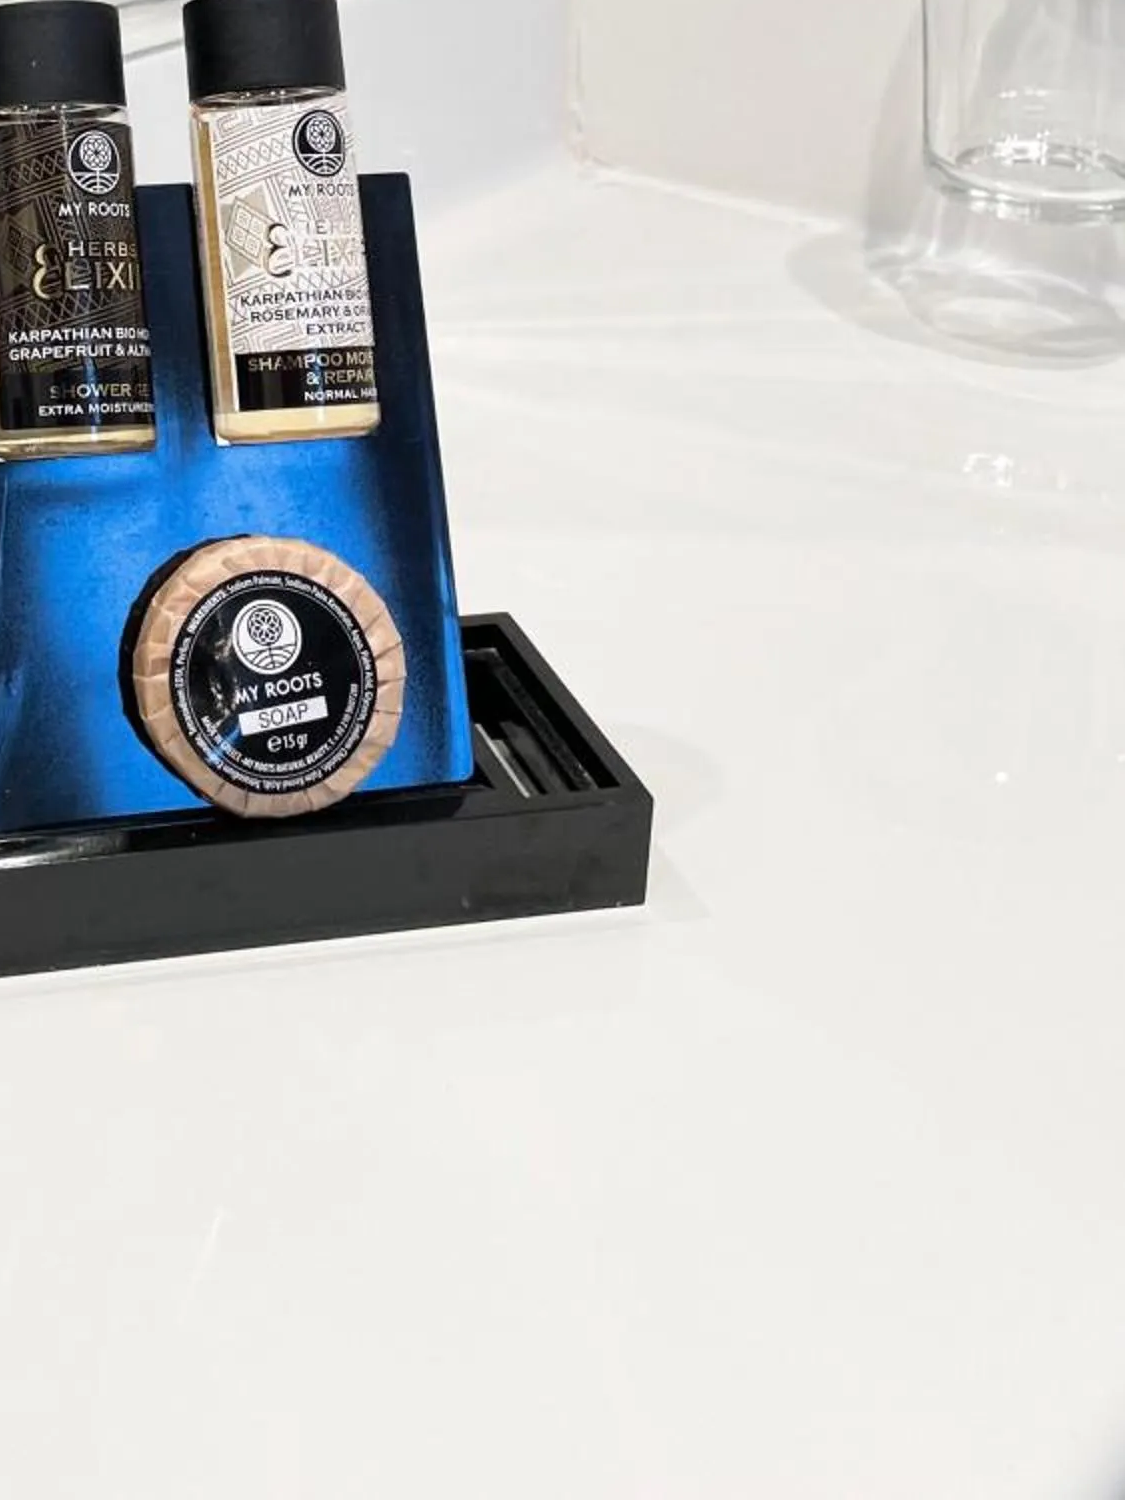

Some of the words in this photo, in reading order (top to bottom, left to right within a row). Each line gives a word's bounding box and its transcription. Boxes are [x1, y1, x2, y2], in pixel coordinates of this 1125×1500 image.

[288, 184, 310, 197] MY
[58, 202, 82, 217] MY
[88, 202, 130, 217] ROOTS
[240, 289, 342, 307] KARPATHIAN
[250, 305, 340, 323] ROSEMARY
[8, 326, 113, 344] KARPATHIAN
[115, 326, 135, 340] BIO
[306, 322, 365, 335] EXTRACT
[9, 343, 113, 361] GRAPEFRUIT
[115, 343, 125, 357] &
[247, 353, 343, 372] SHAMPOO
[306, 371, 321, 385] &
[49, 383, 132, 399] SHOWER
[304, 388, 358, 402] NORMAL
[38, 403, 84, 417] EXTRA
[235, 685, 258, 704] MY
[265, 672, 323, 698] ROOTS
[259, 703, 308, 729] SOAP
